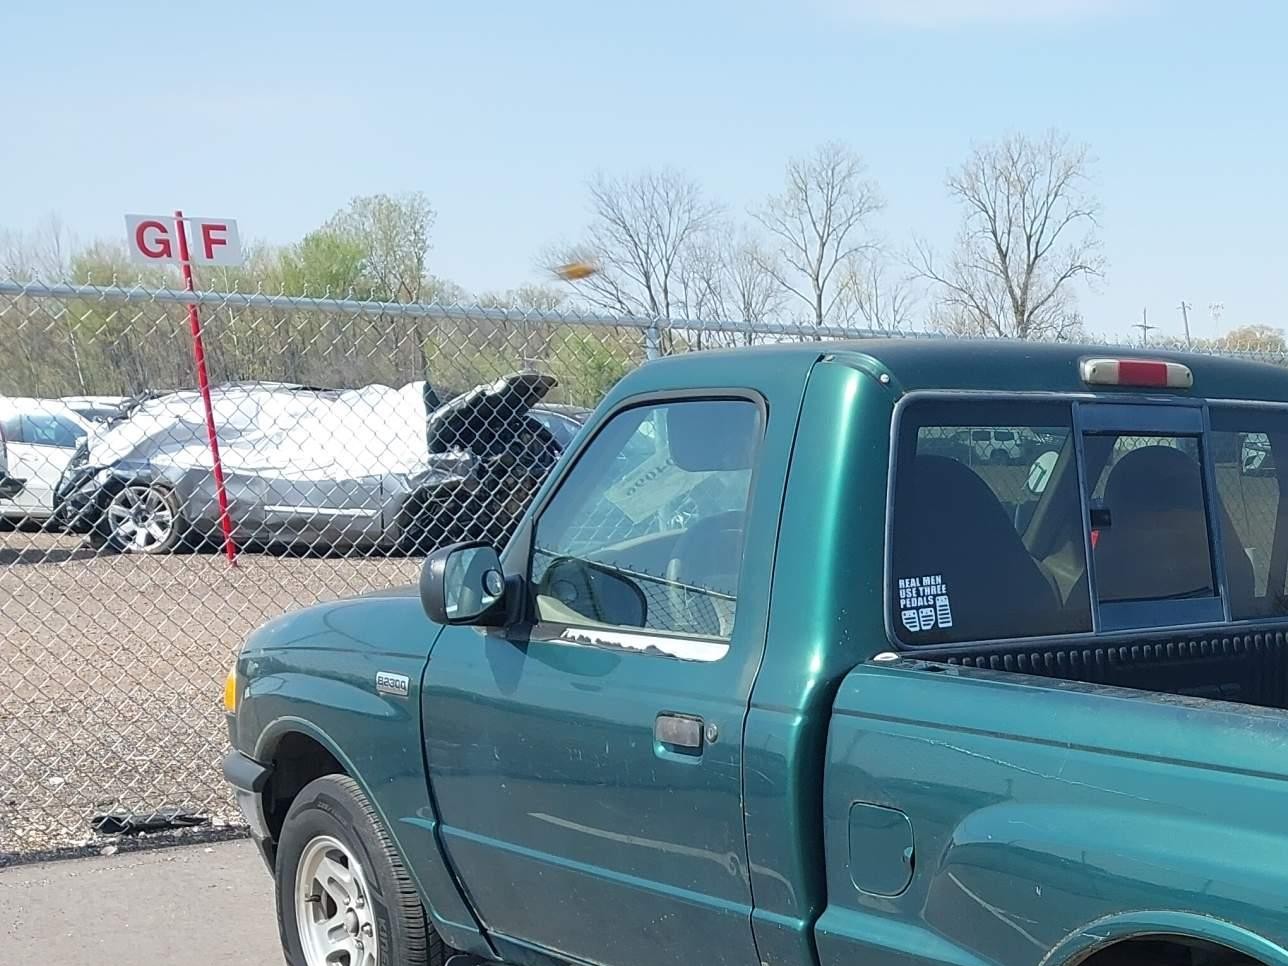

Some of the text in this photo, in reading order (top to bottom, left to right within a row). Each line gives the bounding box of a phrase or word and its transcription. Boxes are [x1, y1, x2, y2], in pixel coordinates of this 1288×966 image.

[135, 220, 227, 259] G F
[899, 575, 942, 588] REAL MEN
[899, 585, 947, 599] USE THREE
[900, 596, 934, 608] PEDALS
